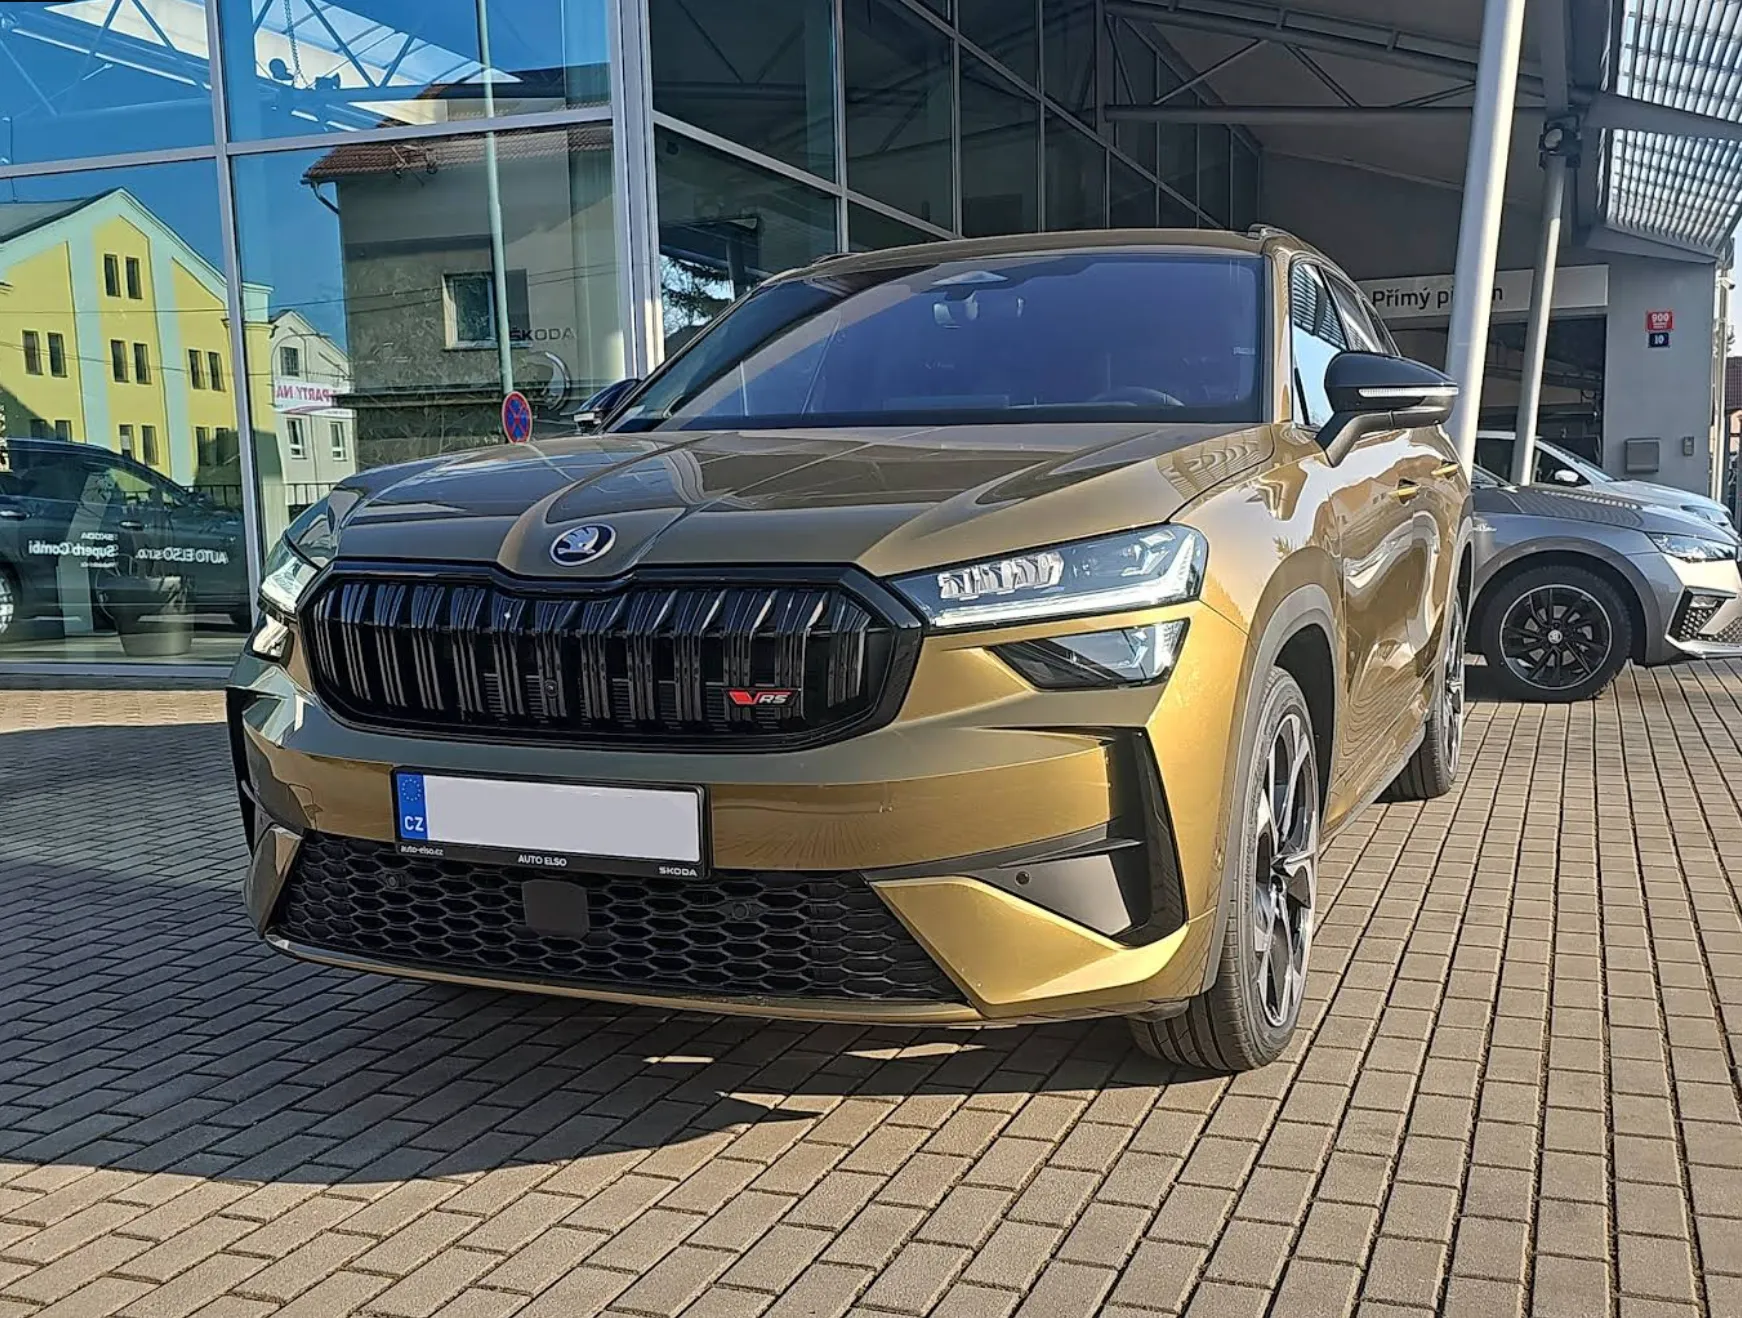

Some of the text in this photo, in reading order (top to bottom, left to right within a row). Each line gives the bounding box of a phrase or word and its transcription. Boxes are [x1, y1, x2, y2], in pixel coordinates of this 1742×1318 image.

[1372, 287, 1431, 310] Přímý
[1651, 312, 1669, 322] 900
[1654, 334, 1664, 344] 10
[405, 815, 424, 831] CZ
[517, 854, 567, 867] AUTO ELSO
